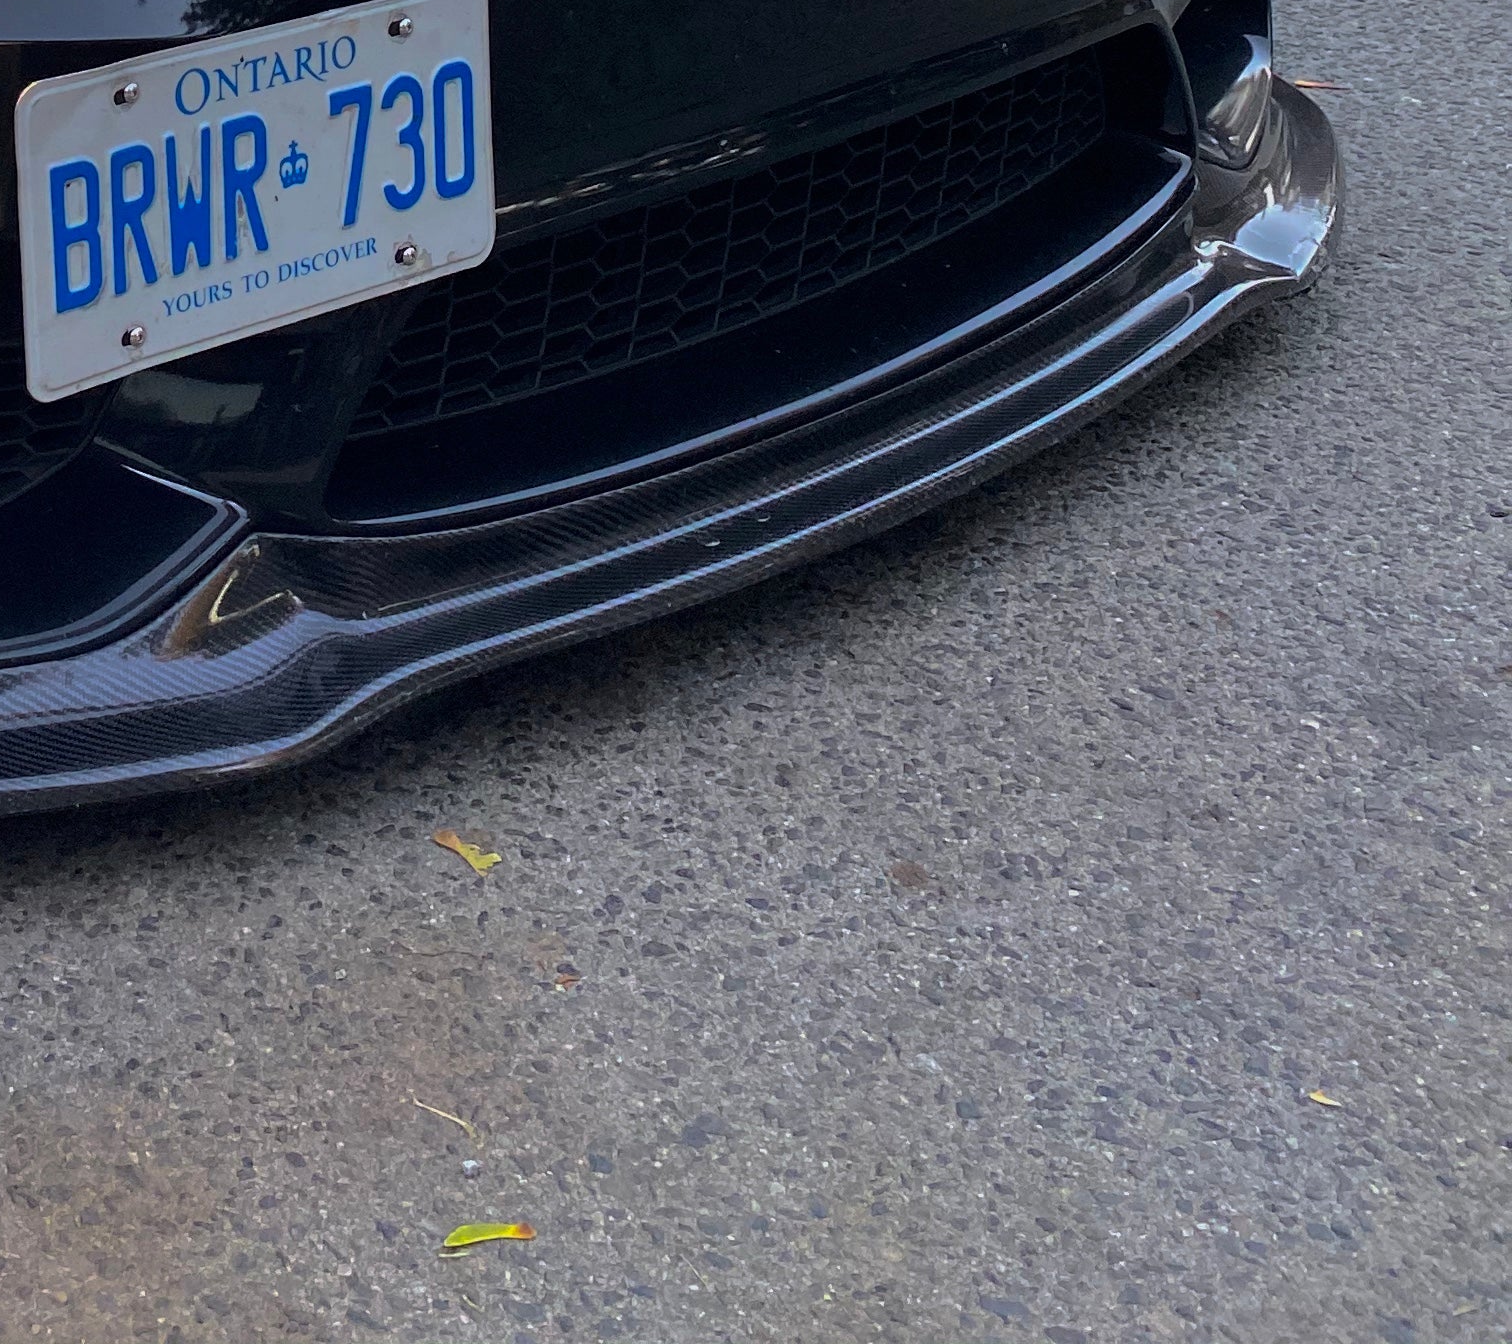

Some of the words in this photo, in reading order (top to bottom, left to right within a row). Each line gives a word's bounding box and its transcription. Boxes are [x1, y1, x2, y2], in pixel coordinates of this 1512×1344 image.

[174, 35, 357, 115] ONTARIO
[49, 114, 269, 314] BRWR
[328, 61, 476, 230] 730
[162, 281, 233, 316] YOURS
[240, 270, 270, 295] TO
[277, 237, 378, 282] DISCOVER
